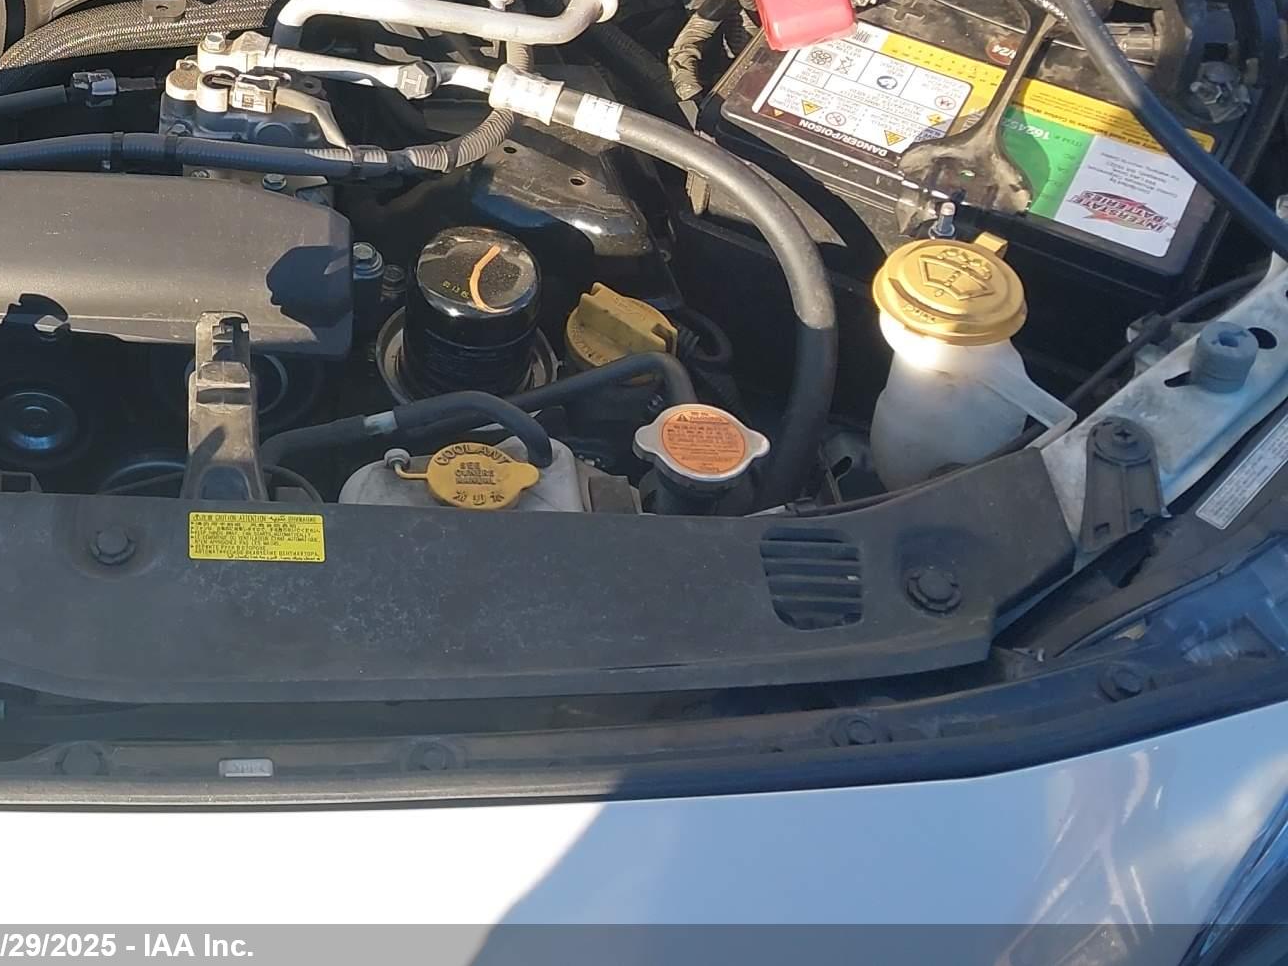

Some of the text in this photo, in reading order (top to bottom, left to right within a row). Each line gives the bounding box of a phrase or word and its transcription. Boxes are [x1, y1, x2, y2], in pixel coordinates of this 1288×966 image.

[799, 118, 888, 157] DANGER/POISON
[1071, 196, 1164, 232] INTERSTATE
[1080, 190, 1168, 224] BATTERIES
[434, 444, 511, 466] COOLANT
